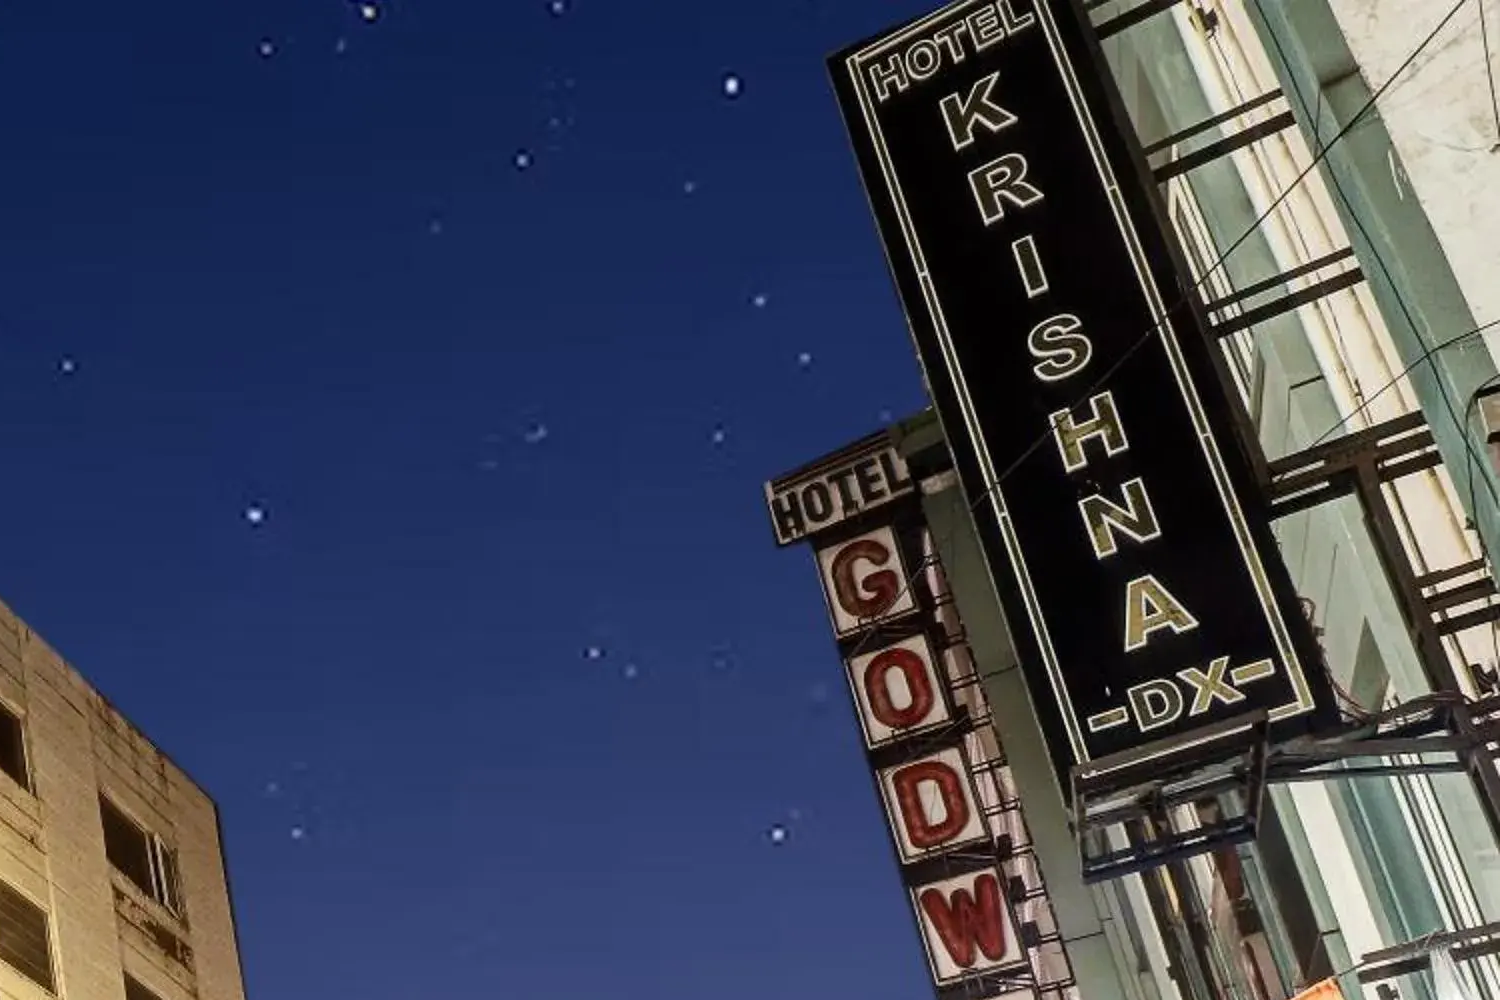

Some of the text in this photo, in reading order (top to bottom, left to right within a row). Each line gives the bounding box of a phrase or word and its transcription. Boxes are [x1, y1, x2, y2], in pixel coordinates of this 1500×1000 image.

[869, 0, 1035, 102] HOTEL
[939, 70, 1200, 653] KRISHNA
[771, 451, 913, 540] HOTEL
